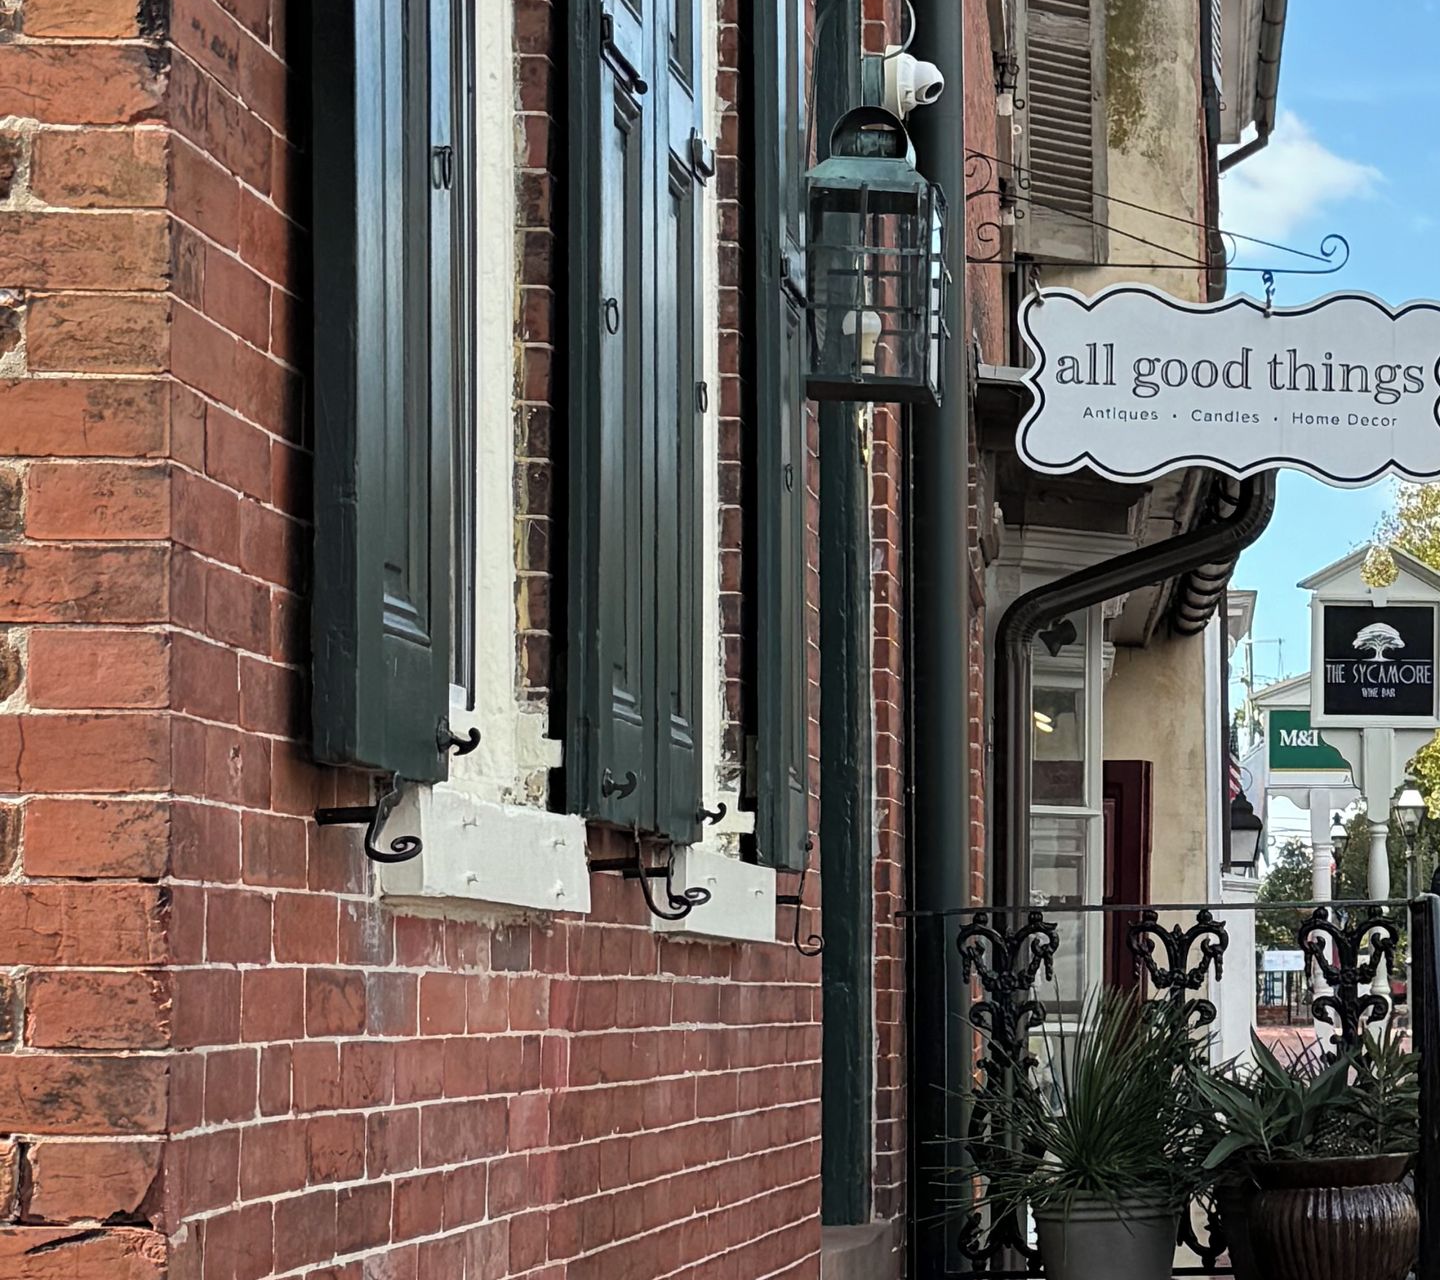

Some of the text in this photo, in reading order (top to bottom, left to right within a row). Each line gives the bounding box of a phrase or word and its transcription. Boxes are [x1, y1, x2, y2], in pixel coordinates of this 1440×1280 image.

[1055, 342, 1425, 405] all good things
[1082, 405, 1398, 428] Antiques Candles Home Decor
[1325, 663, 1433, 685] THE SYCAMORE
